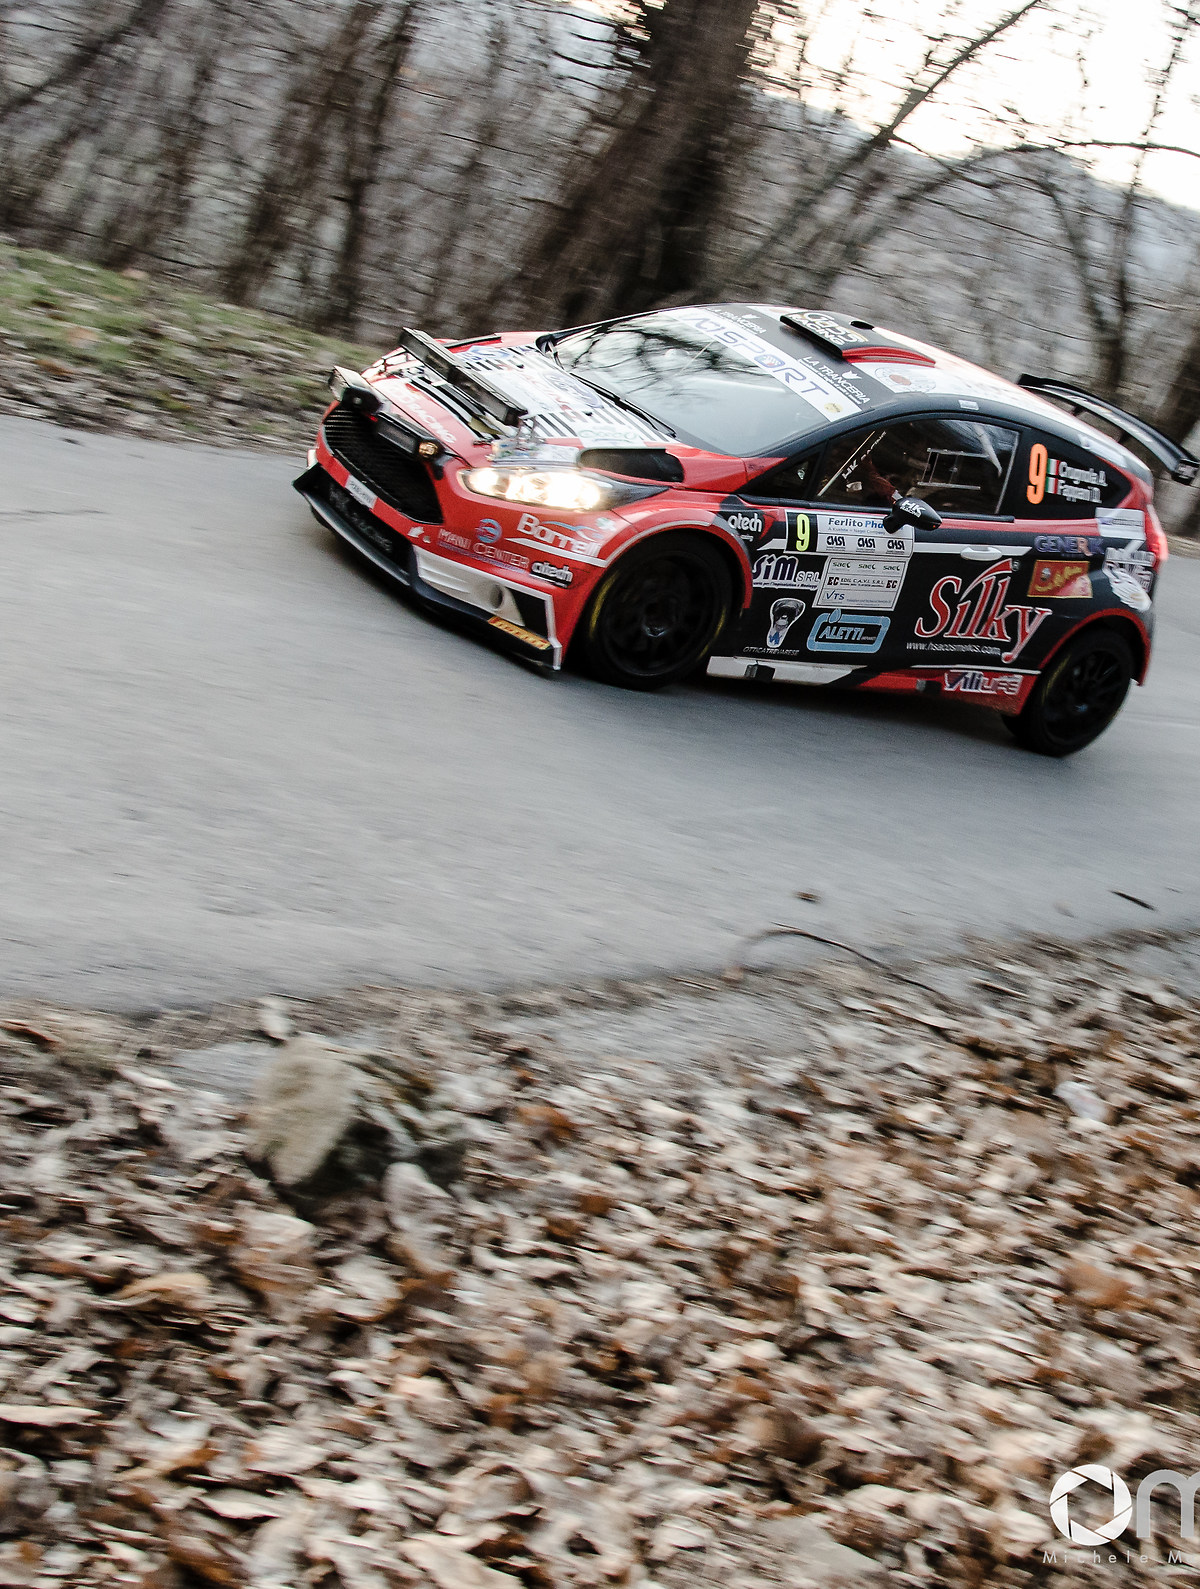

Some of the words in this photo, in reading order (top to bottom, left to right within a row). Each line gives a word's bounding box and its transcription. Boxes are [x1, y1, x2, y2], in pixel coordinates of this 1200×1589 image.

[789, 314, 846, 346] RACING
[802, 356, 820, 368] LA
[817, 364, 871, 405] TRANCERIA
[841, 459, 859, 480] HK
[1026, 443, 1048, 505] 9
[901, 499, 926, 517] HK
[795, 513, 811, 552] 9
[828, 517, 864, 528] Ferlito
[472, 542, 530, 568] CENTER
[796, 572, 820, 583] SRL
[914, 558, 1053, 664] Silky
[818, 625, 865, 640] ALETTI
